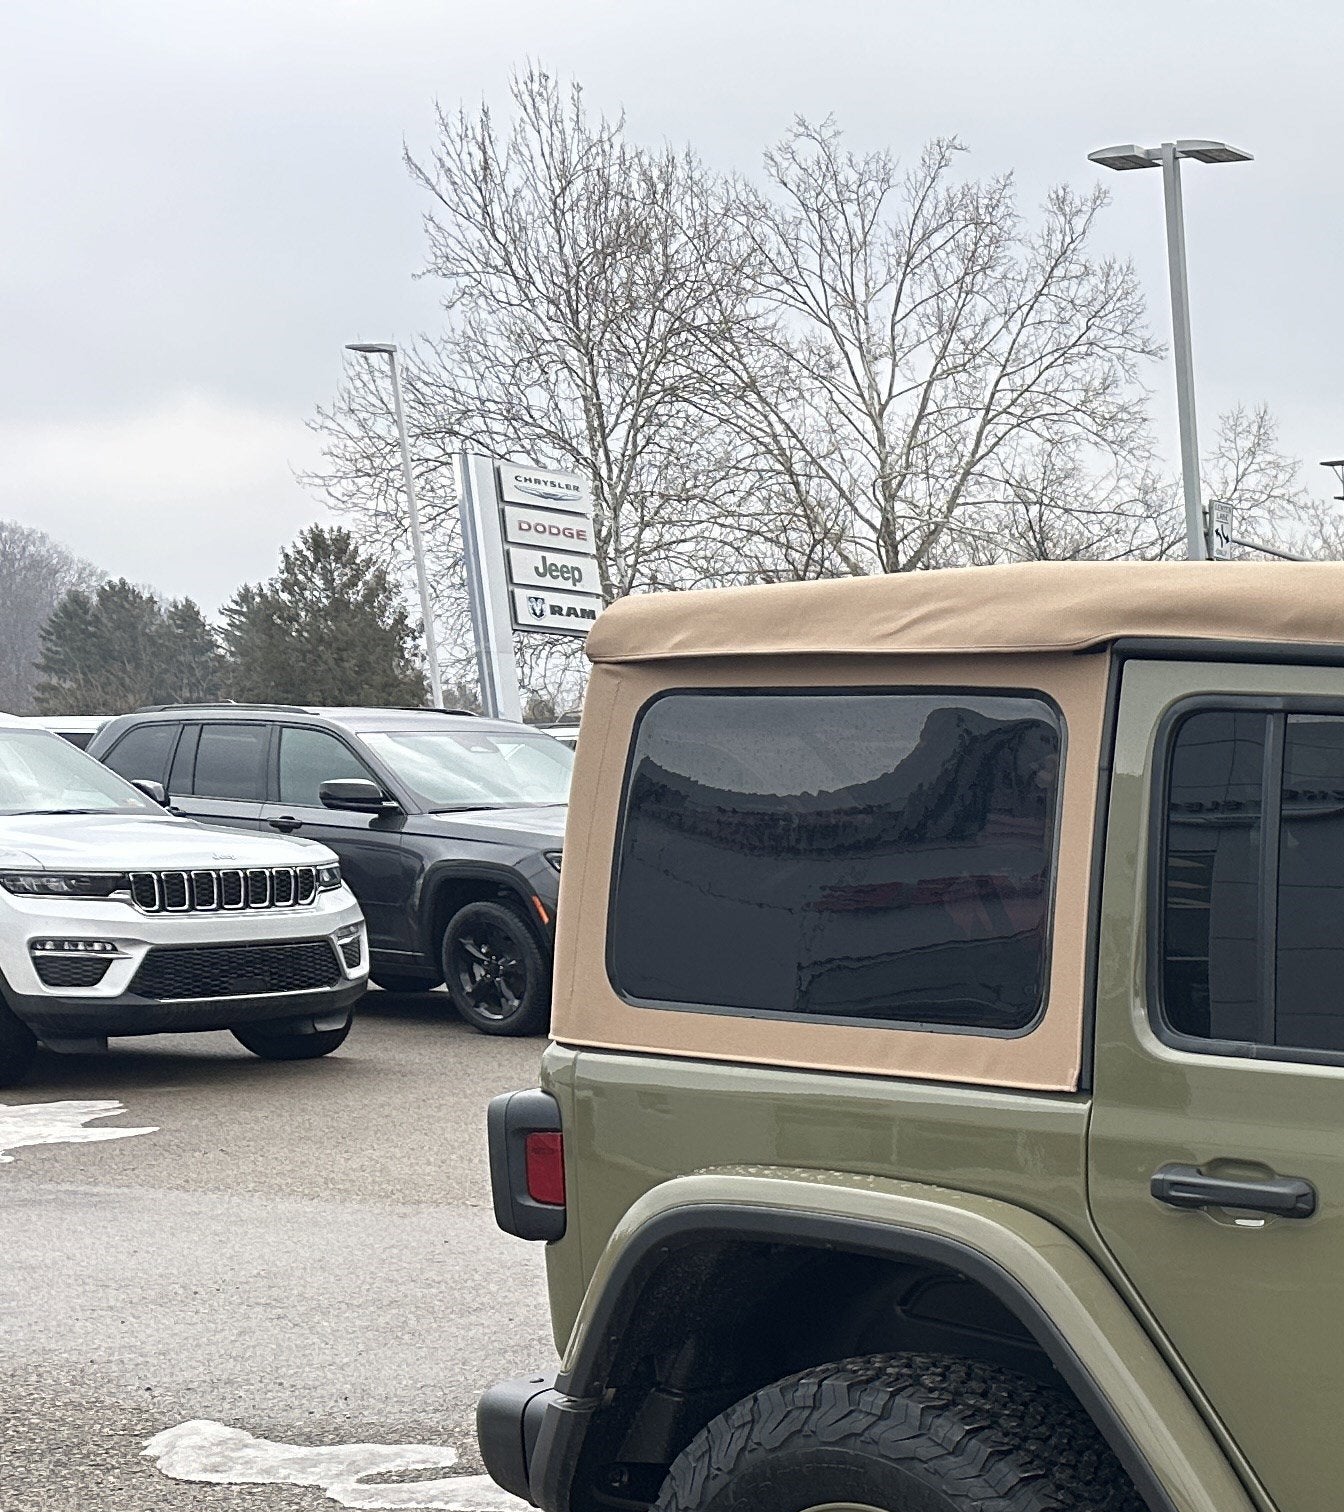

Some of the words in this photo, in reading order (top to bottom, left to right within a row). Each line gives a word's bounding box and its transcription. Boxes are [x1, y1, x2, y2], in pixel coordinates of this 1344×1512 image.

[514, 475, 580, 492] CHRYSLER
[518, 519, 588, 541] DODGE
[534, 556, 583, 587] Jeep
[549, 604, 597, 620] RAM
